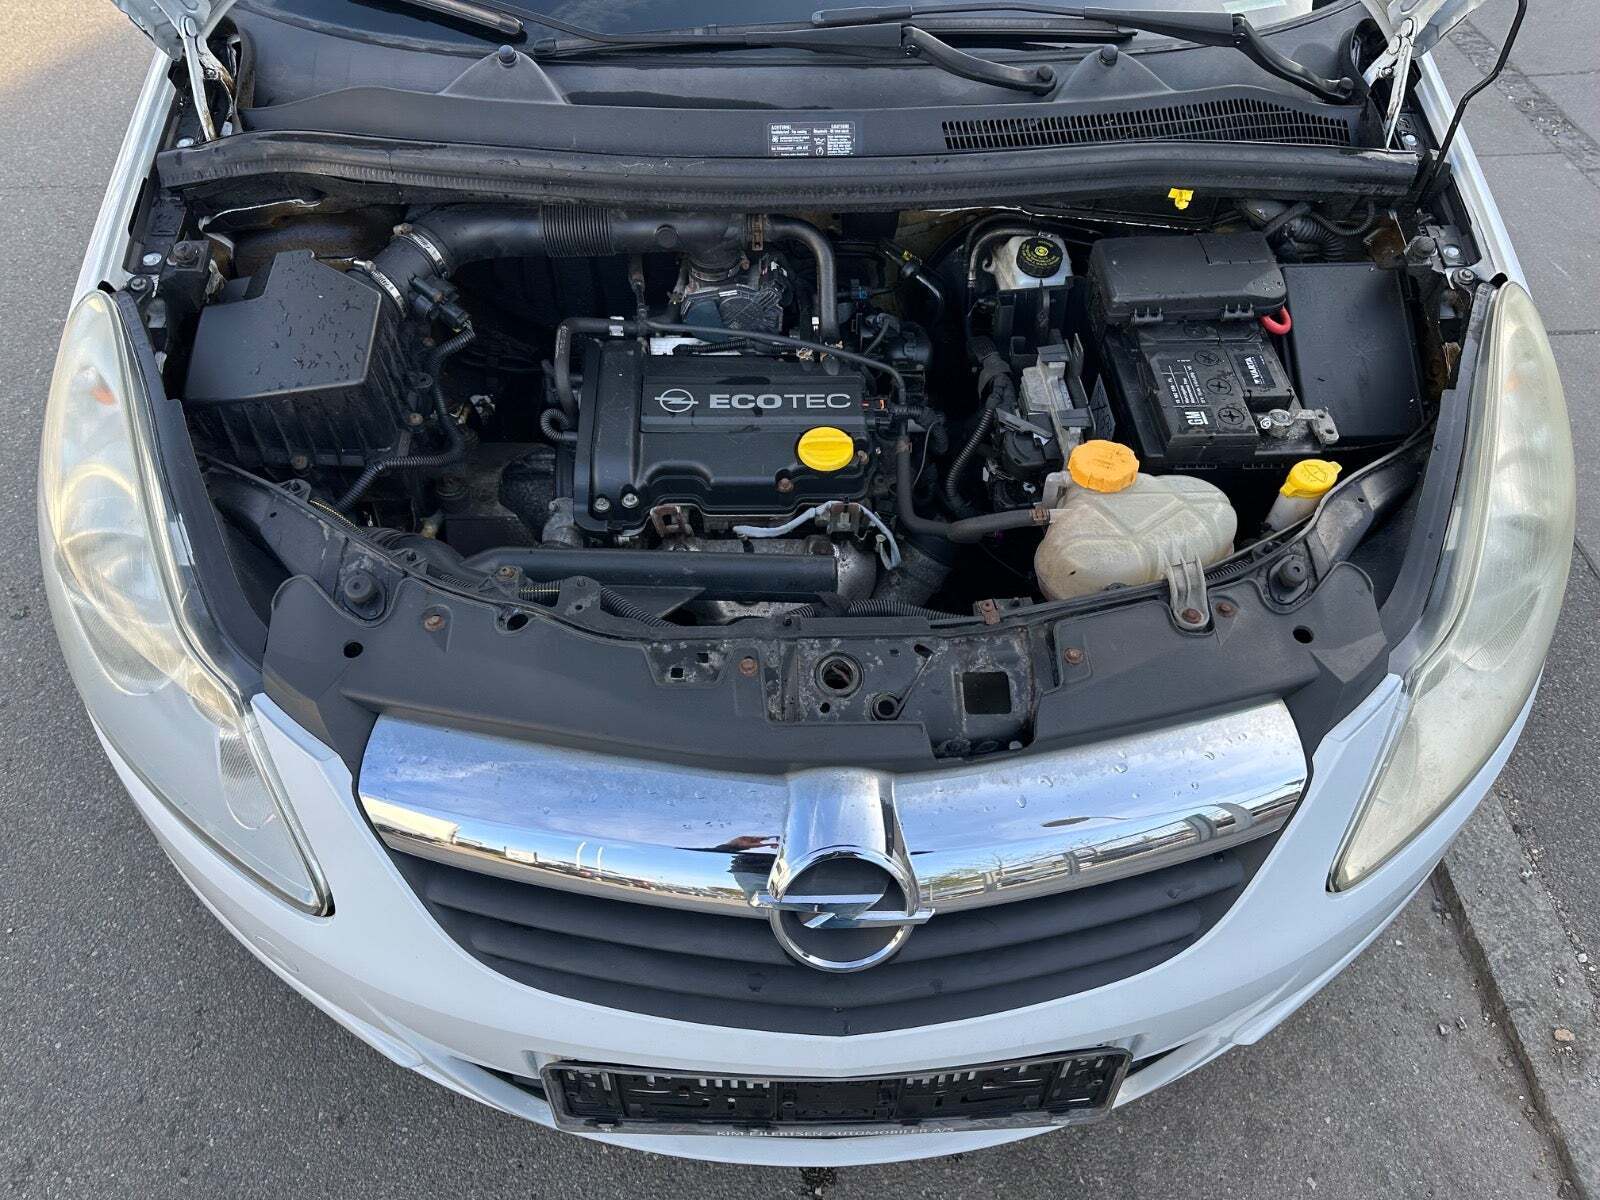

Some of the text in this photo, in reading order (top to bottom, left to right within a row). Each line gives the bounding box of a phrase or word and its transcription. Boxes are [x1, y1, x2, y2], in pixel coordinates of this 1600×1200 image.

[1244, 356, 1260, 379] VARTA
[709, 393, 851, 409] ECOTEC
[1185, 411, 1204, 425] GM
